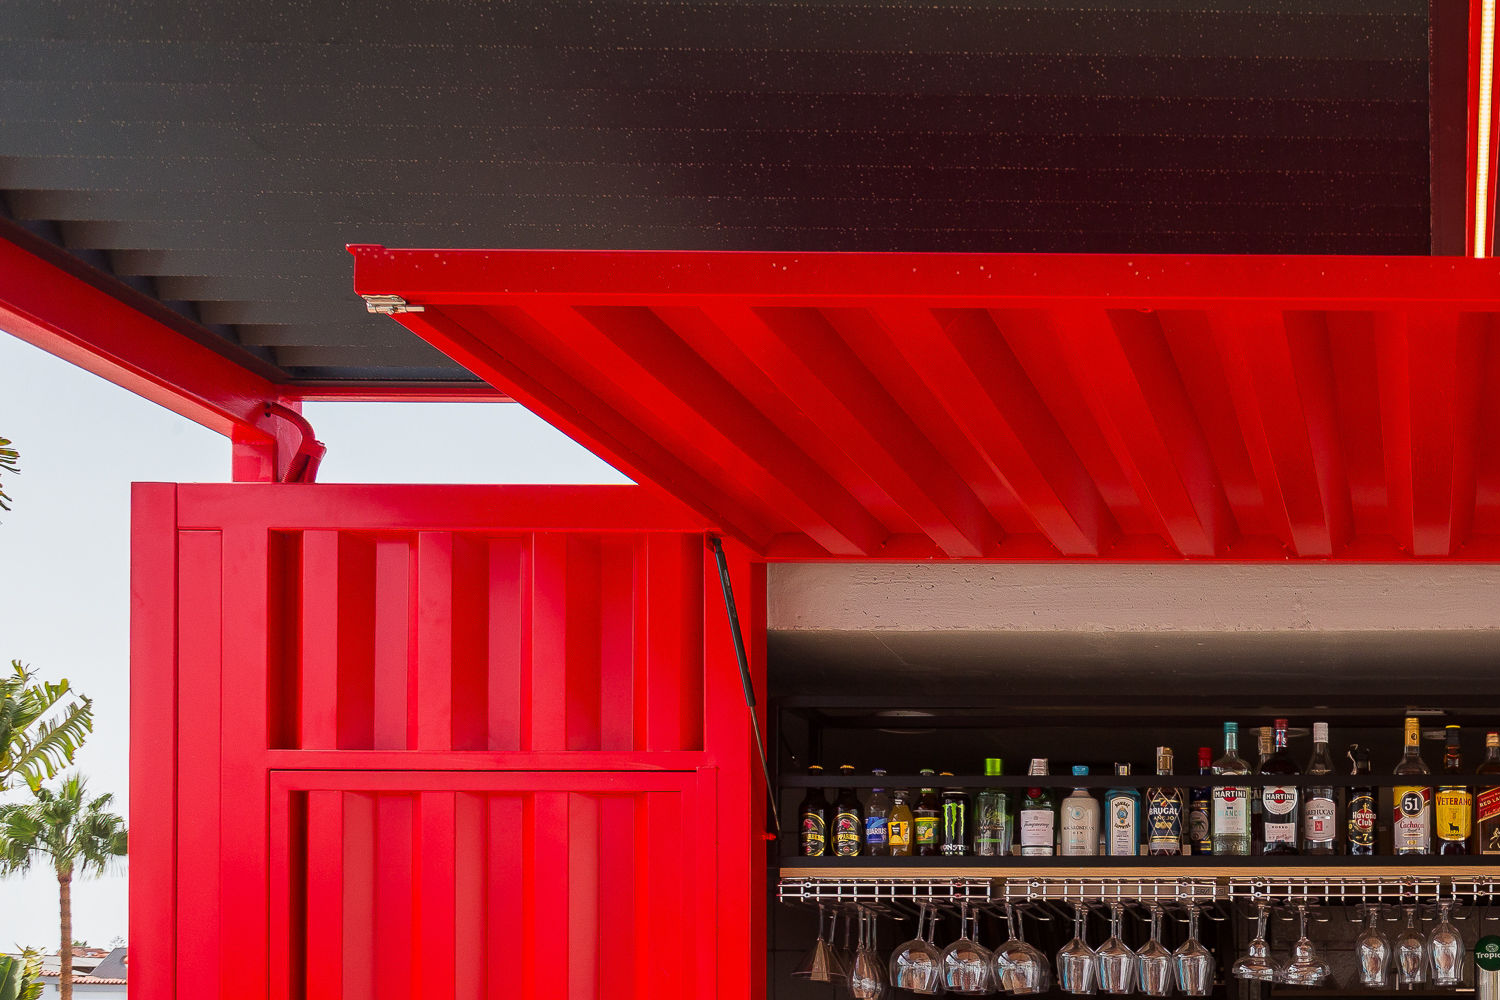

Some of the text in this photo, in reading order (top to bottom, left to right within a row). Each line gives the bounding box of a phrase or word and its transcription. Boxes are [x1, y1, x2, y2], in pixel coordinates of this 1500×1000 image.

[1214, 790, 1247, 798] MARTINI
[1266, 793, 1295, 801] MARTINI
[1404, 798, 1419, 811] 51
[1437, 797, 1472, 806] VETERANO
[1149, 807, 1179, 816] BRUGAL
[1352, 811, 1376, 820] Havana
[1357, 819, 1373, 827] Club
[1363, 833, 1369, 841] 7
